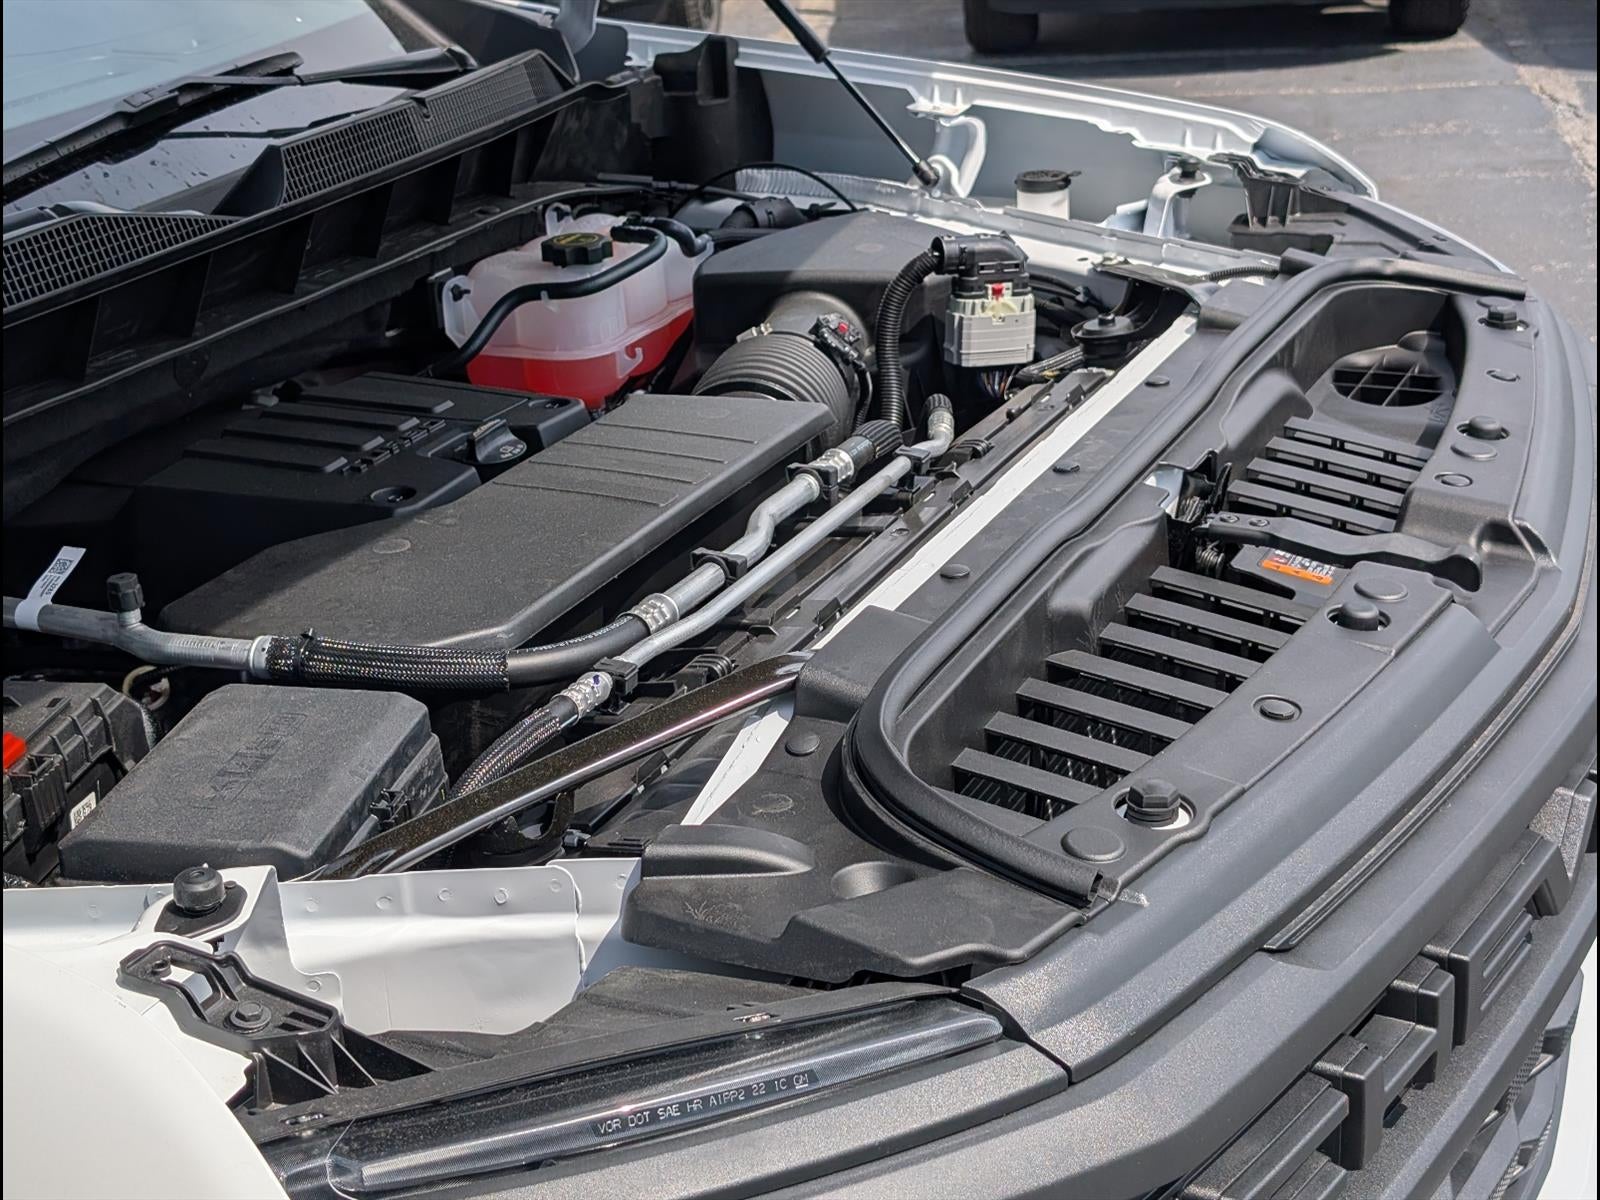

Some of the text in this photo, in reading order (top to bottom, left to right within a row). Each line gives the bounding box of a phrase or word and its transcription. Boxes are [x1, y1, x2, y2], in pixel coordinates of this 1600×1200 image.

[597, 1118, 622, 1134] VOR
[627, 1110, 651, 1127] DOT
[657, 1103, 681, 1120] SAE
[686, 1098, 703, 1113] HR
[751, 1082, 766, 1096] 22
